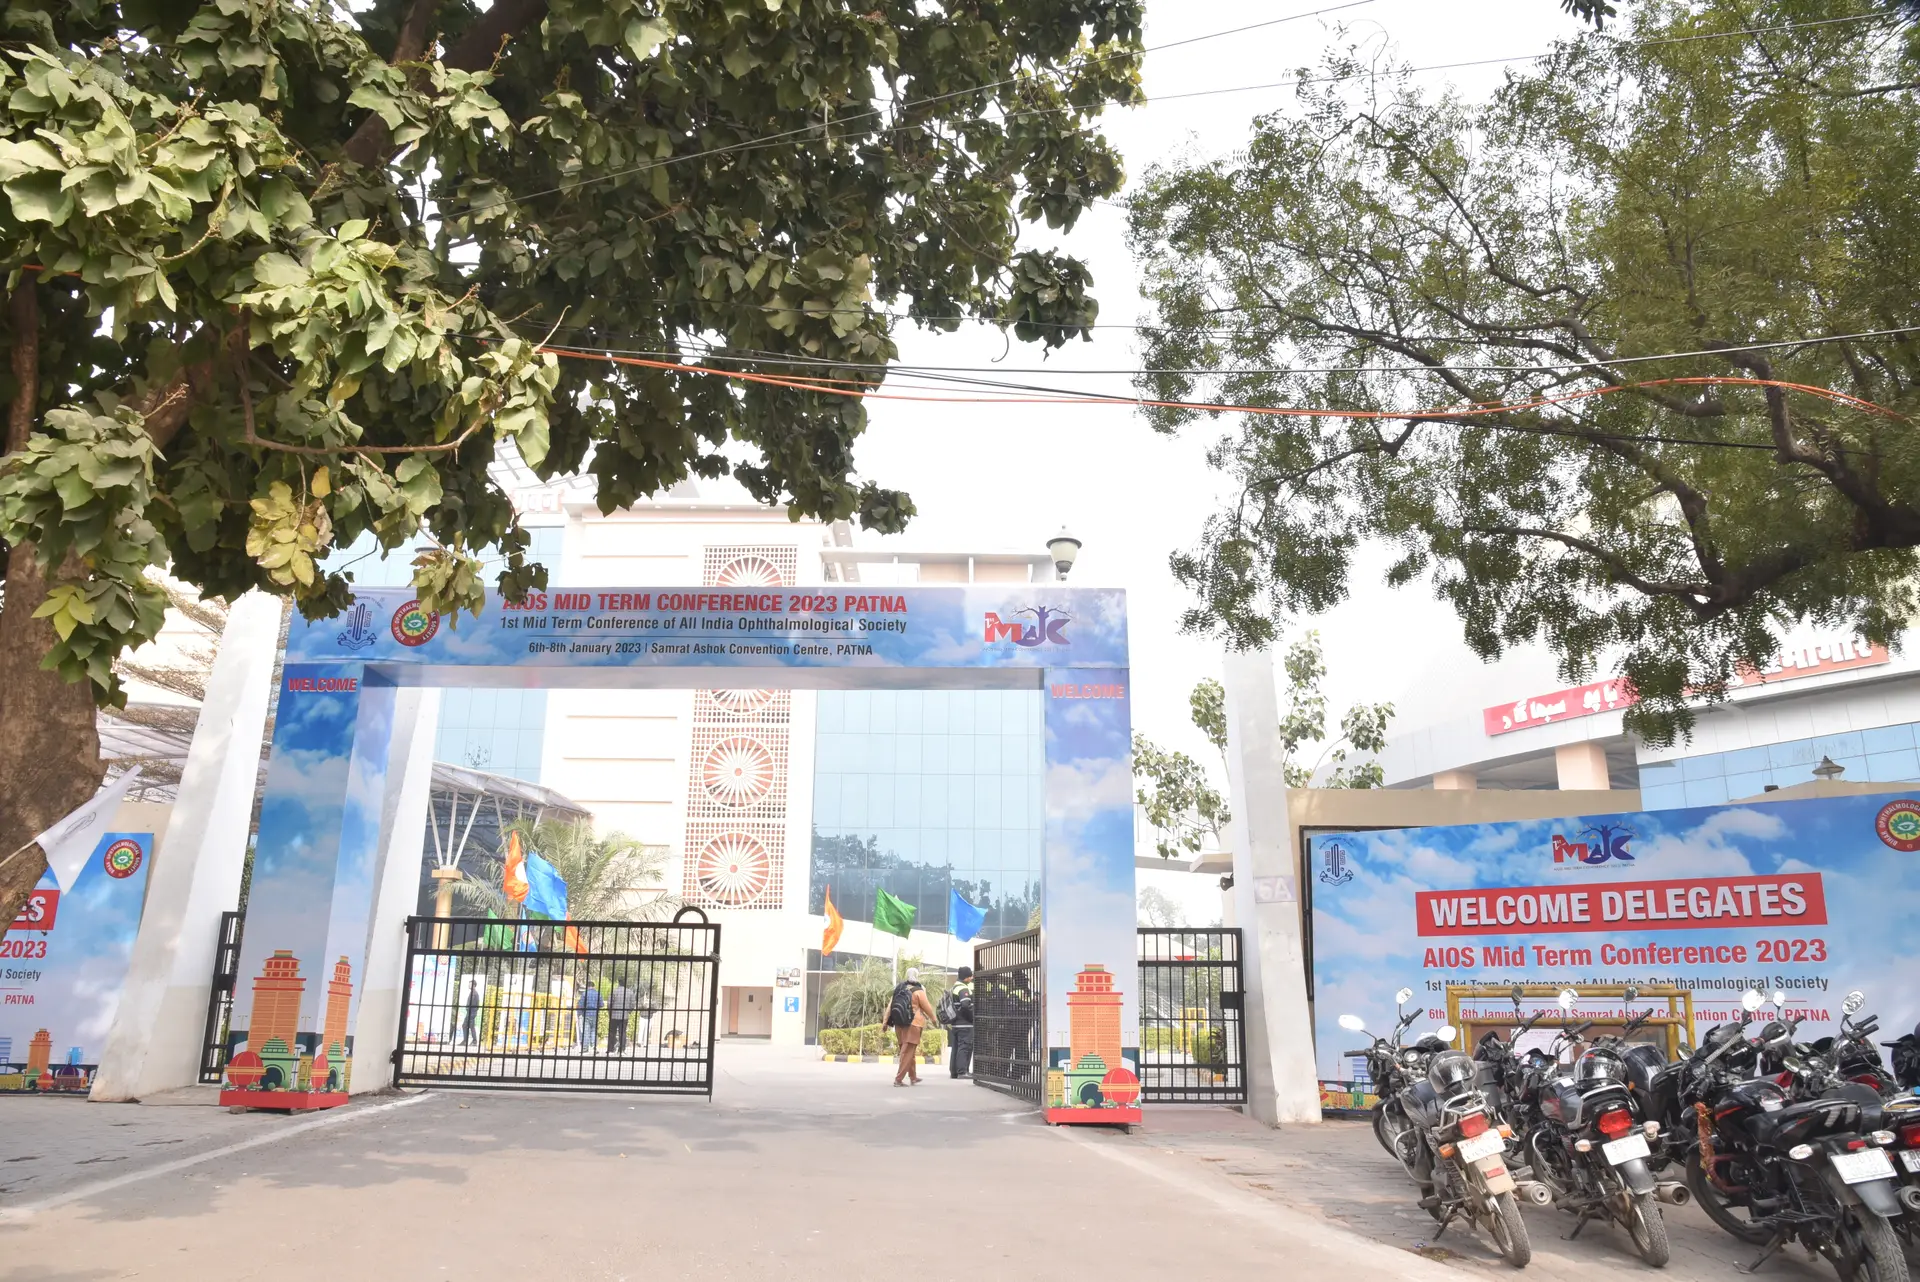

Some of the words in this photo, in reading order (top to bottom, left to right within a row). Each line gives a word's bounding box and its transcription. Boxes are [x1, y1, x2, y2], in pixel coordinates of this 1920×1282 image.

[554, 594, 591, 610] MID
[598, 594, 650, 610] TERM
[657, 594, 782, 612] CONFERENCE
[789, 595, 838, 612] 2023
[845, 596, 907, 612] PATNA
[500, 616, 519, 629] 1st
[523, 616, 546, 629] Mid
[552, 617, 581, 629] Term
[587, 617, 659, 630] Conference
[664, 616, 676, 630] of
[680, 617, 696, 630] All
[701, 617, 734, 631] India
[738, 617, 853, 633] Ophthalmological
[858, 619, 907, 634] Society
[528, 642, 566, 653] 6th-8th
[570, 642, 612, 656] January
[615, 642, 642, 654] 2023
[652, 642, 690, 654] Samrat
[692, 643, 726, 654] Ashok
[729, 643, 790, 655] Convention
[793, 644, 832, 656] Centre,
[837, 644, 873, 656] PATNA
[288, 678, 358, 692] WELCOME
[1051, 683, 1125, 699] WELCOME
[1430, 892, 1590, 927] WELCOME
[1601, 882, 1806, 921] DELEGATES
[0, 940, 47, 959] 2023
[1423, 946, 1474, 968] AIOS
[1482, 946, 1525, 968] Mid
[1532, 946, 1592, 967] Term
[1600, 942, 1747, 966] Conference
[1756, 938, 1828, 962] 2023
[6, 968, 42, 982] Society
[1425, 980, 1442, 991] 1st
[1775, 976, 1828, 992] Society
[5, 995, 34, 1004] PATNA
[1429, 1008, 1445, 1020] 6th
[1462, 1008, 1478, 1018] 8th
[1482, 1008, 1525, 1018] Januay
[1572, 1009, 1614, 1018] Samrat
[1658, 1009, 1728, 1020] Covntion
[1732, 1009, 1774, 1021] Cntre
[1785, 1009, 1830, 1022] PATNA
